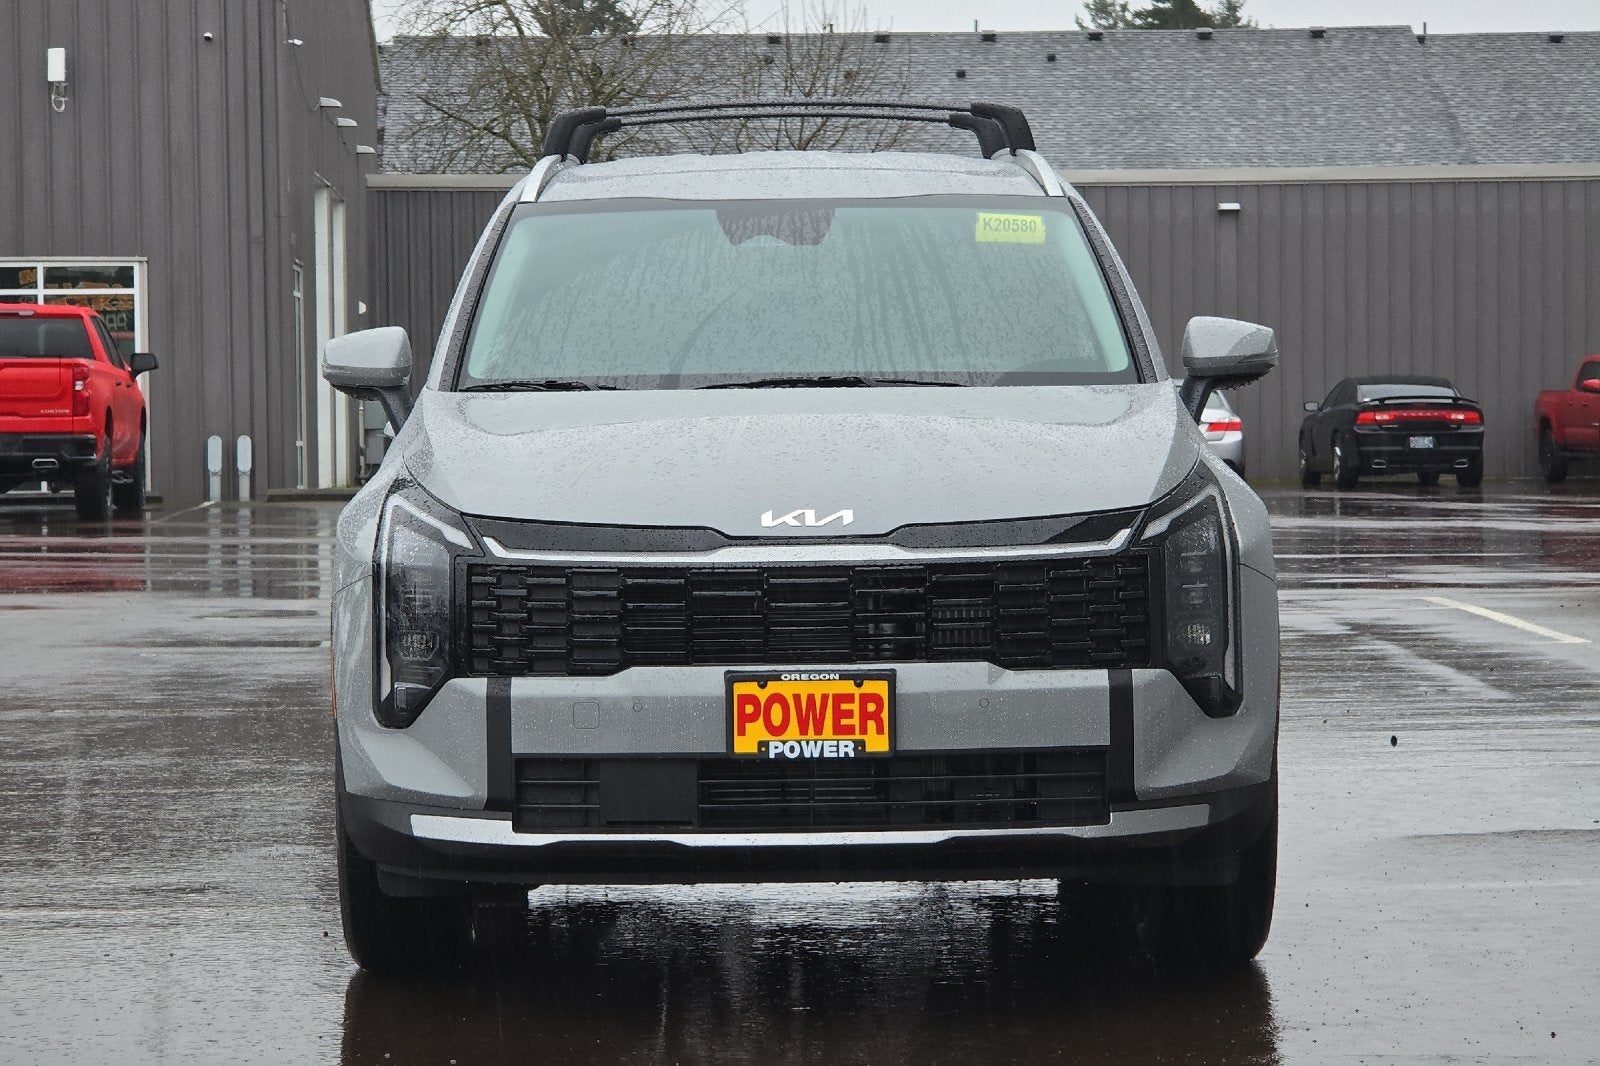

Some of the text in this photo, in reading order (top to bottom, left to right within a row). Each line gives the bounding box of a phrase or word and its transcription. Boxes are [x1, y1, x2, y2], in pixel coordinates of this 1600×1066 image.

[983, 217, 1037, 232] K20580
[761, 509, 853, 527] KIA
[781, 673, 839, 681] OREGON
[737, 693, 885, 736] POWER
[769, 740, 855, 758] POWER
